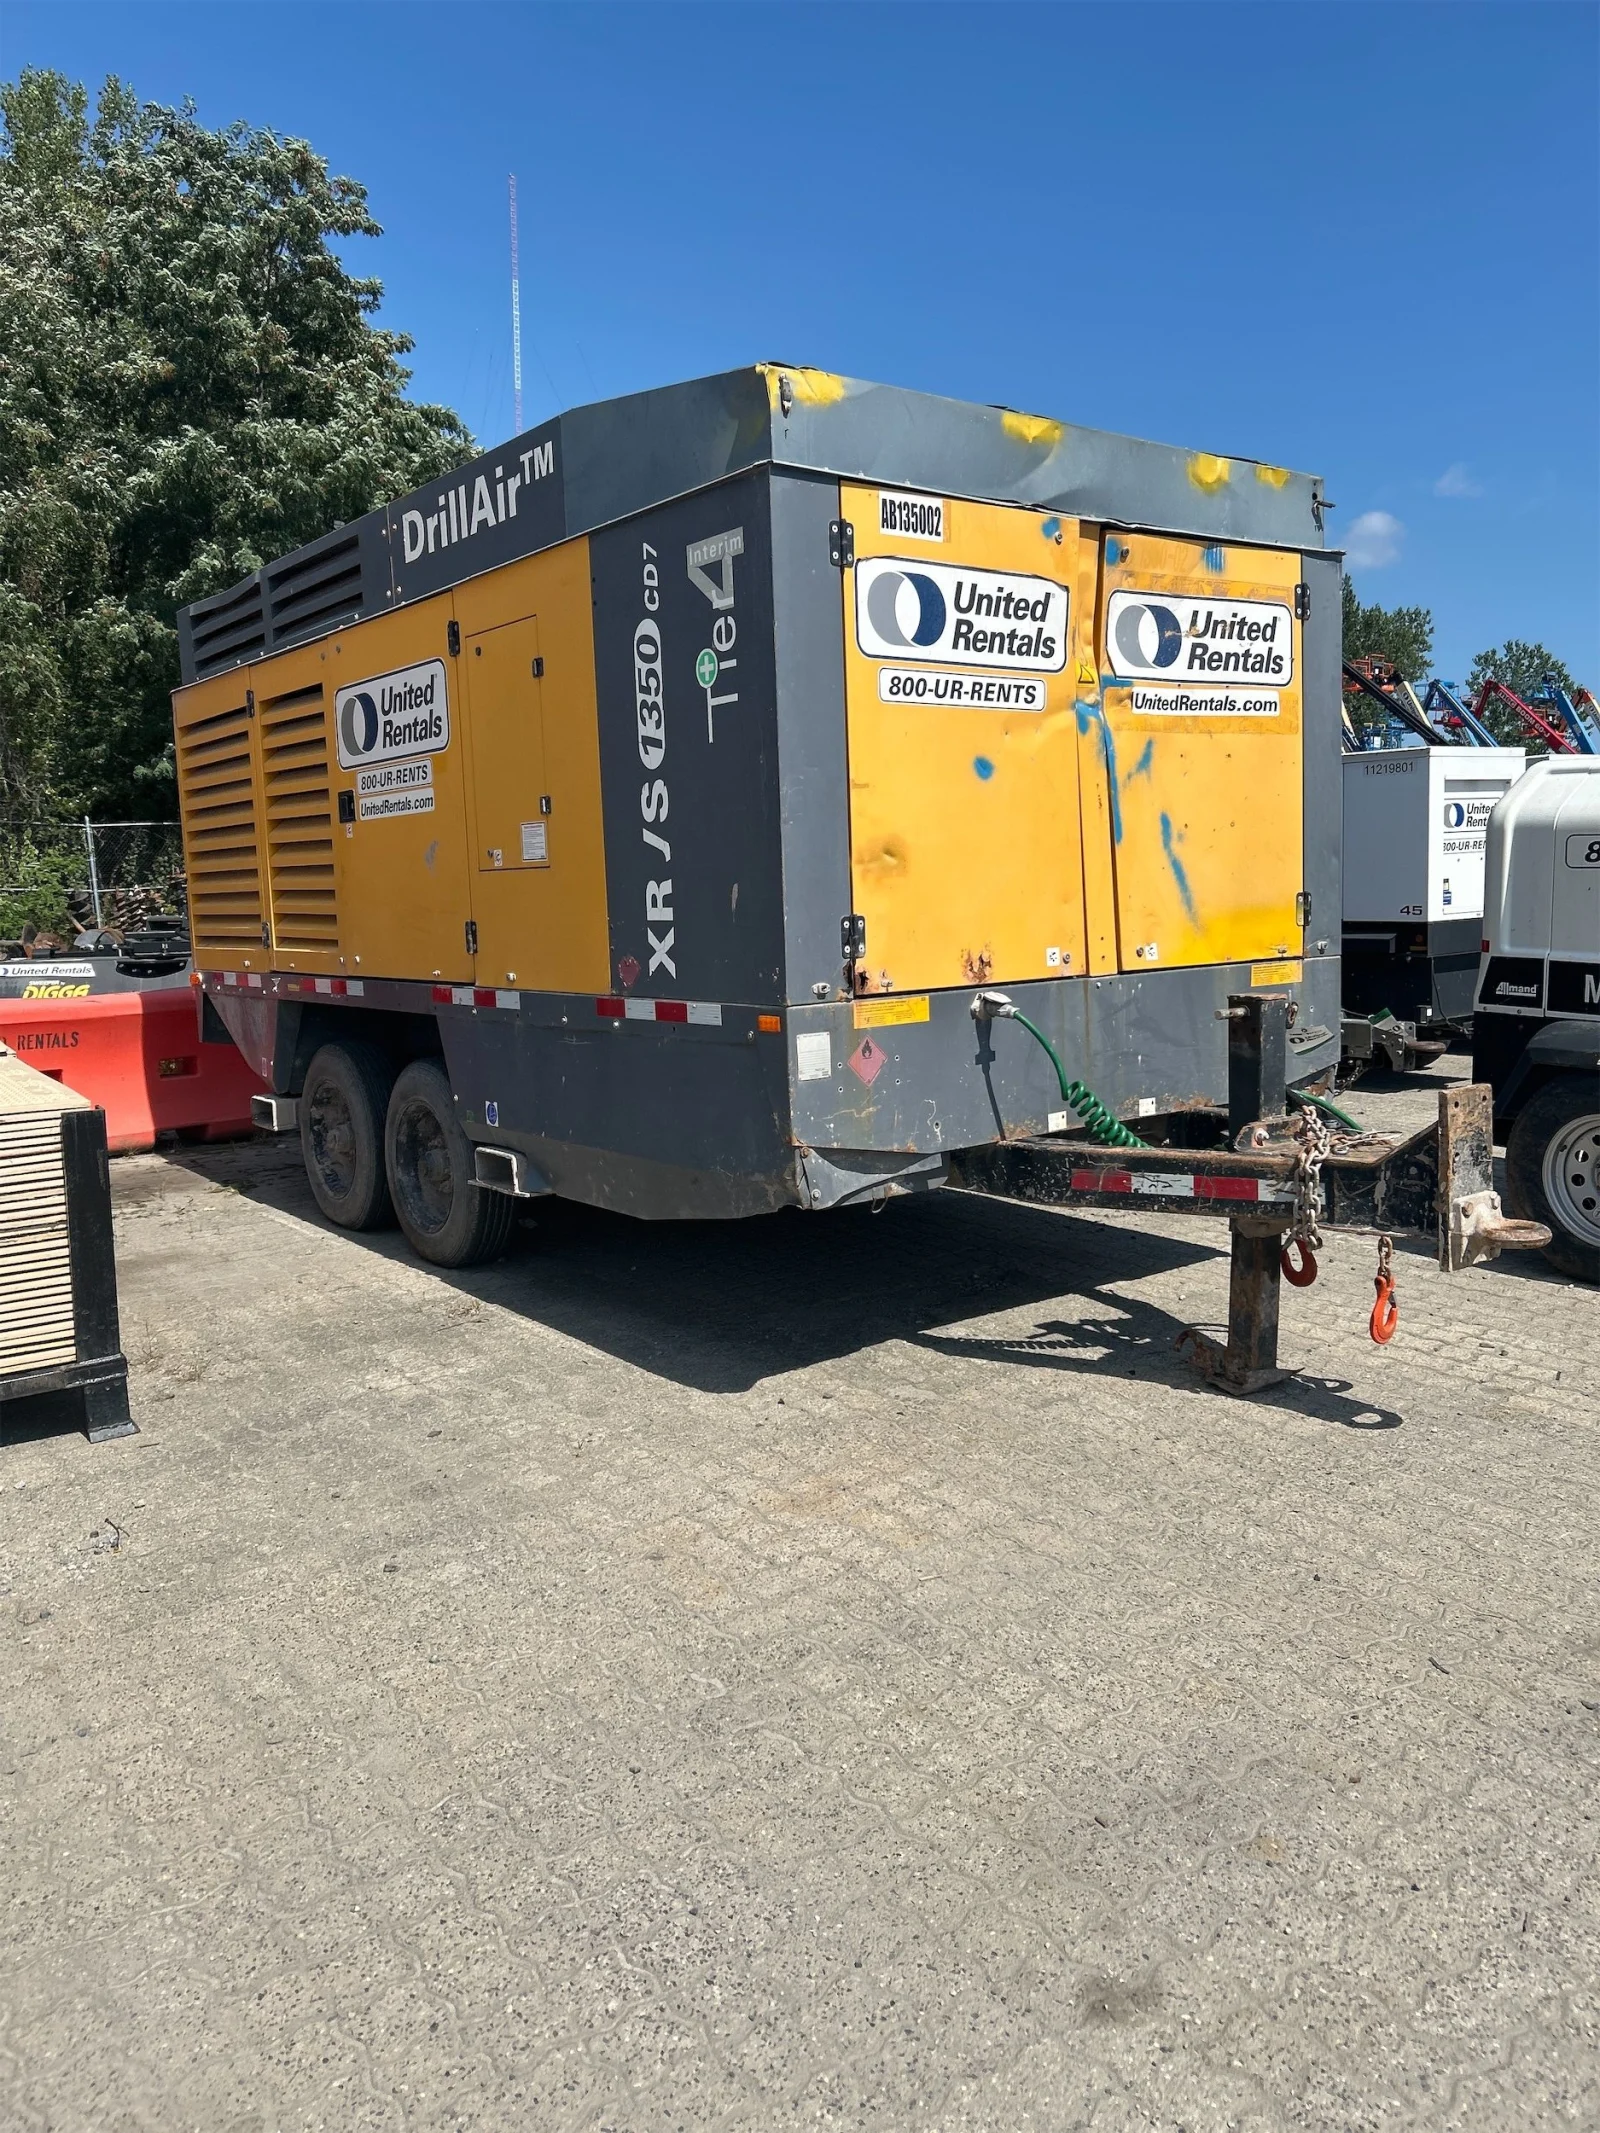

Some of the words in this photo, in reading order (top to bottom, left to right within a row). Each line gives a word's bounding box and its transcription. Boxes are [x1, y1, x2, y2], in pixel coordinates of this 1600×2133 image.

[881, 498, 942, 537] AB135002
[688, 534, 742, 566] Interim
[643, 542, 660, 612] CD7
[953, 581, 1052, 623] United
[952, 618, 1056, 659] Rentals
[1189, 610, 1278, 643] United
[1187, 642, 1284, 674] Rentals
[381, 674, 435, 717] United
[636, 633, 663, 756] 1350
[888, 676, 1037, 705] 800-UR-RENTS
[1133, 692, 1278, 713] UnitedRentals.com
[383, 709, 442, 749] Rentals
[361, 764, 428, 791] 800-UR-RENTS
[1364, 762, 1414, 776] 11219801
[361, 796, 434, 818] UnitedRentals.com
[1400, 905, 1423, 916] 45
[12, 967, 48, 975] United
[51, 966, 92, 975] Rentals
[22, 984, 91, 999] DIGGA
[1495, 981, 1538, 997] Allmand
[17, 1031, 80, 1051] RENTALS
